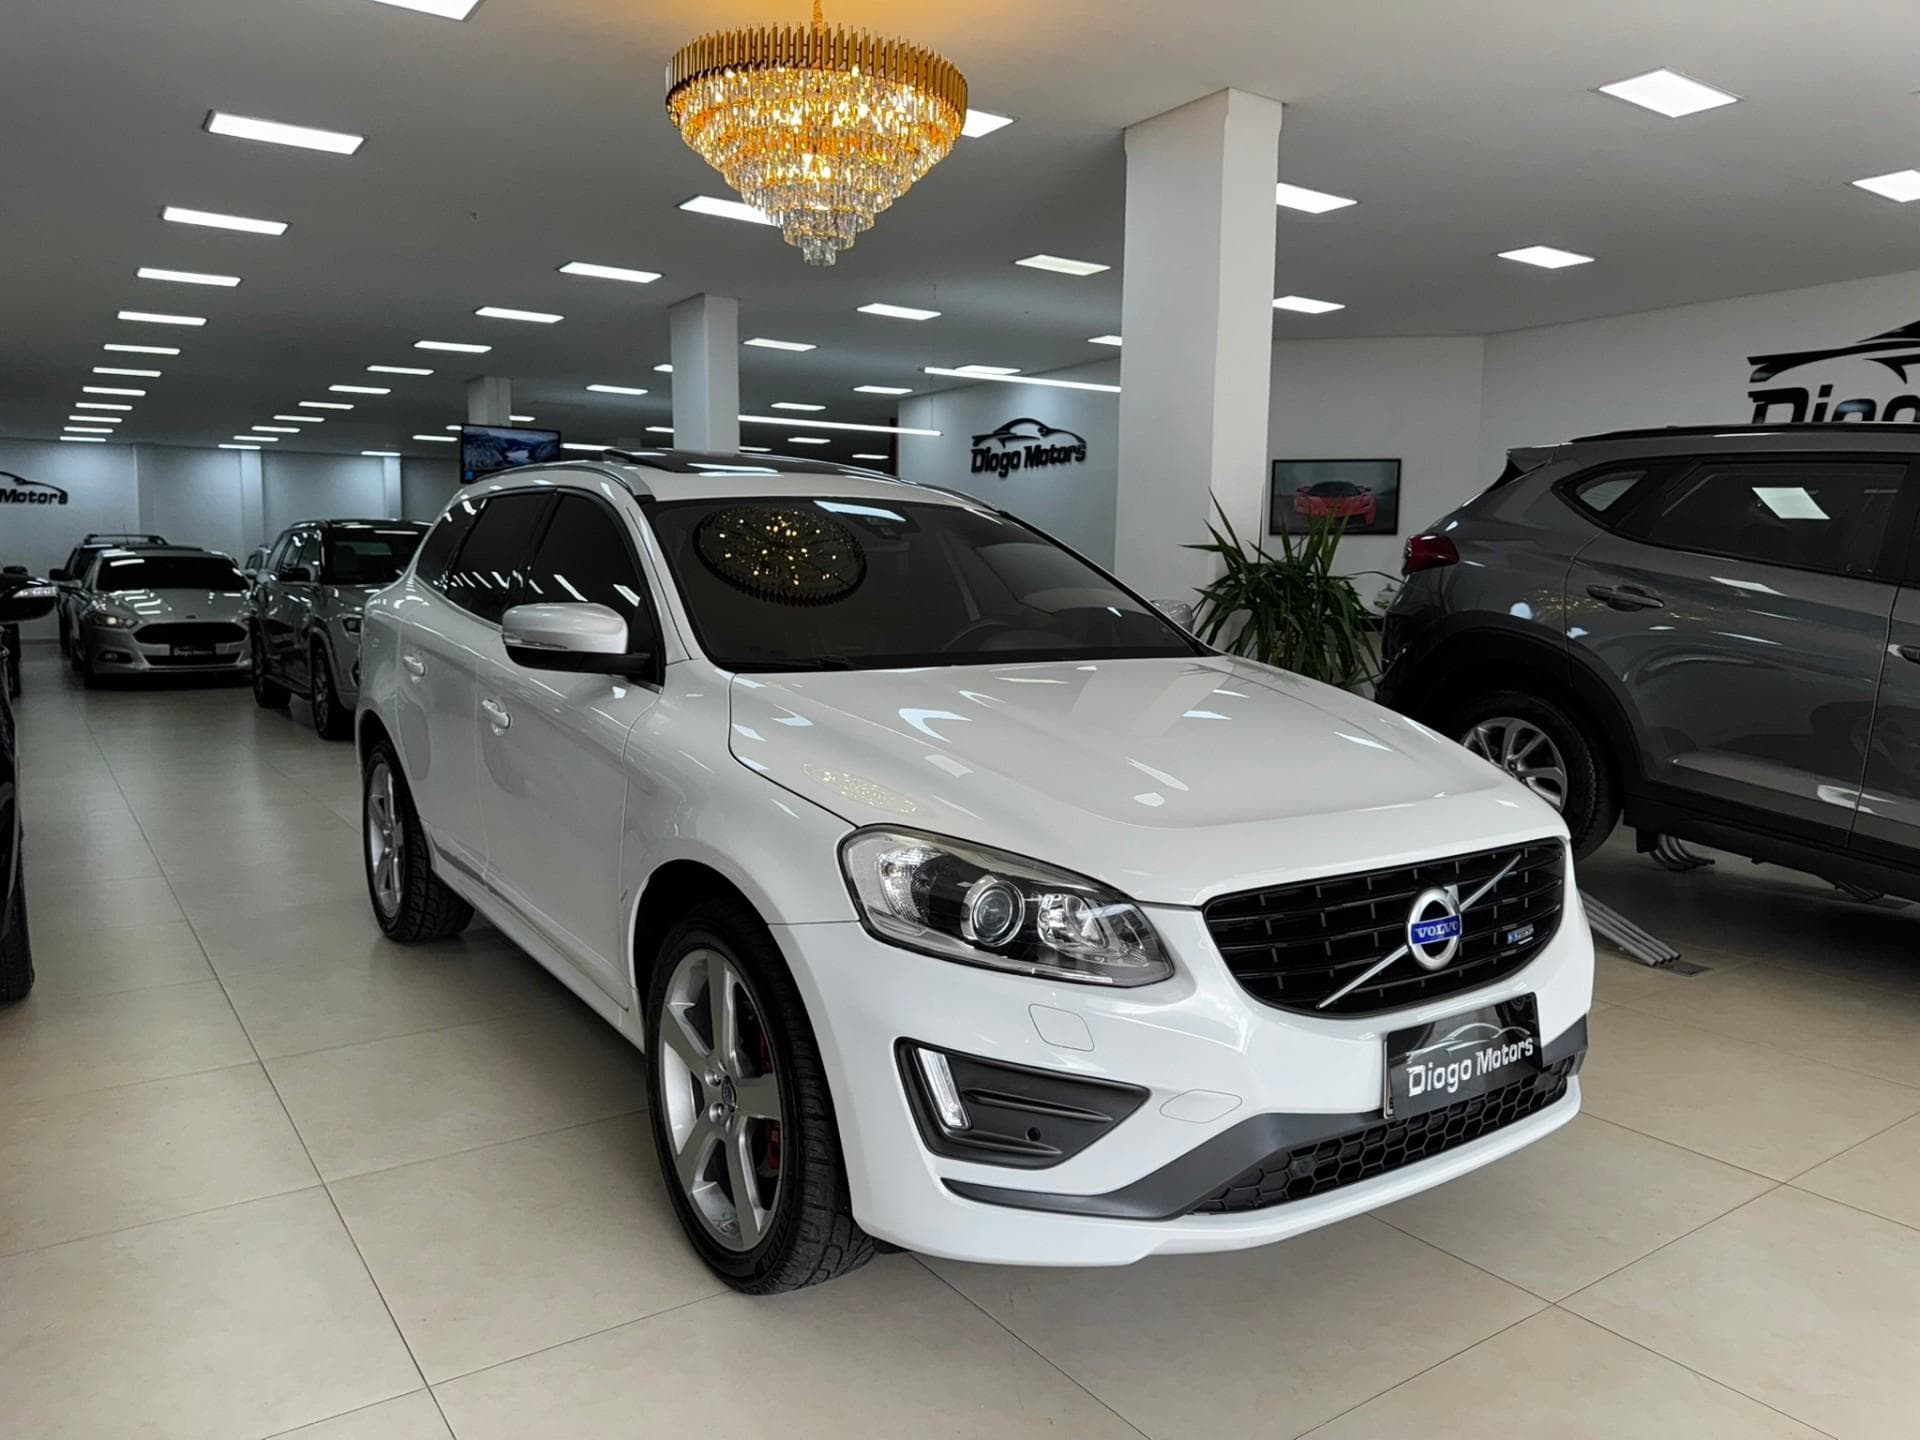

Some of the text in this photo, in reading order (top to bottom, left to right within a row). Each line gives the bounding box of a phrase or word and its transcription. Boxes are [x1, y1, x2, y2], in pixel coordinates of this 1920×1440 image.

[970, 443, 1087, 478] Diogo Motors
[1415, 919, 1459, 938] VOLVO
[1406, 1037, 1534, 1097] Diogo Motors
